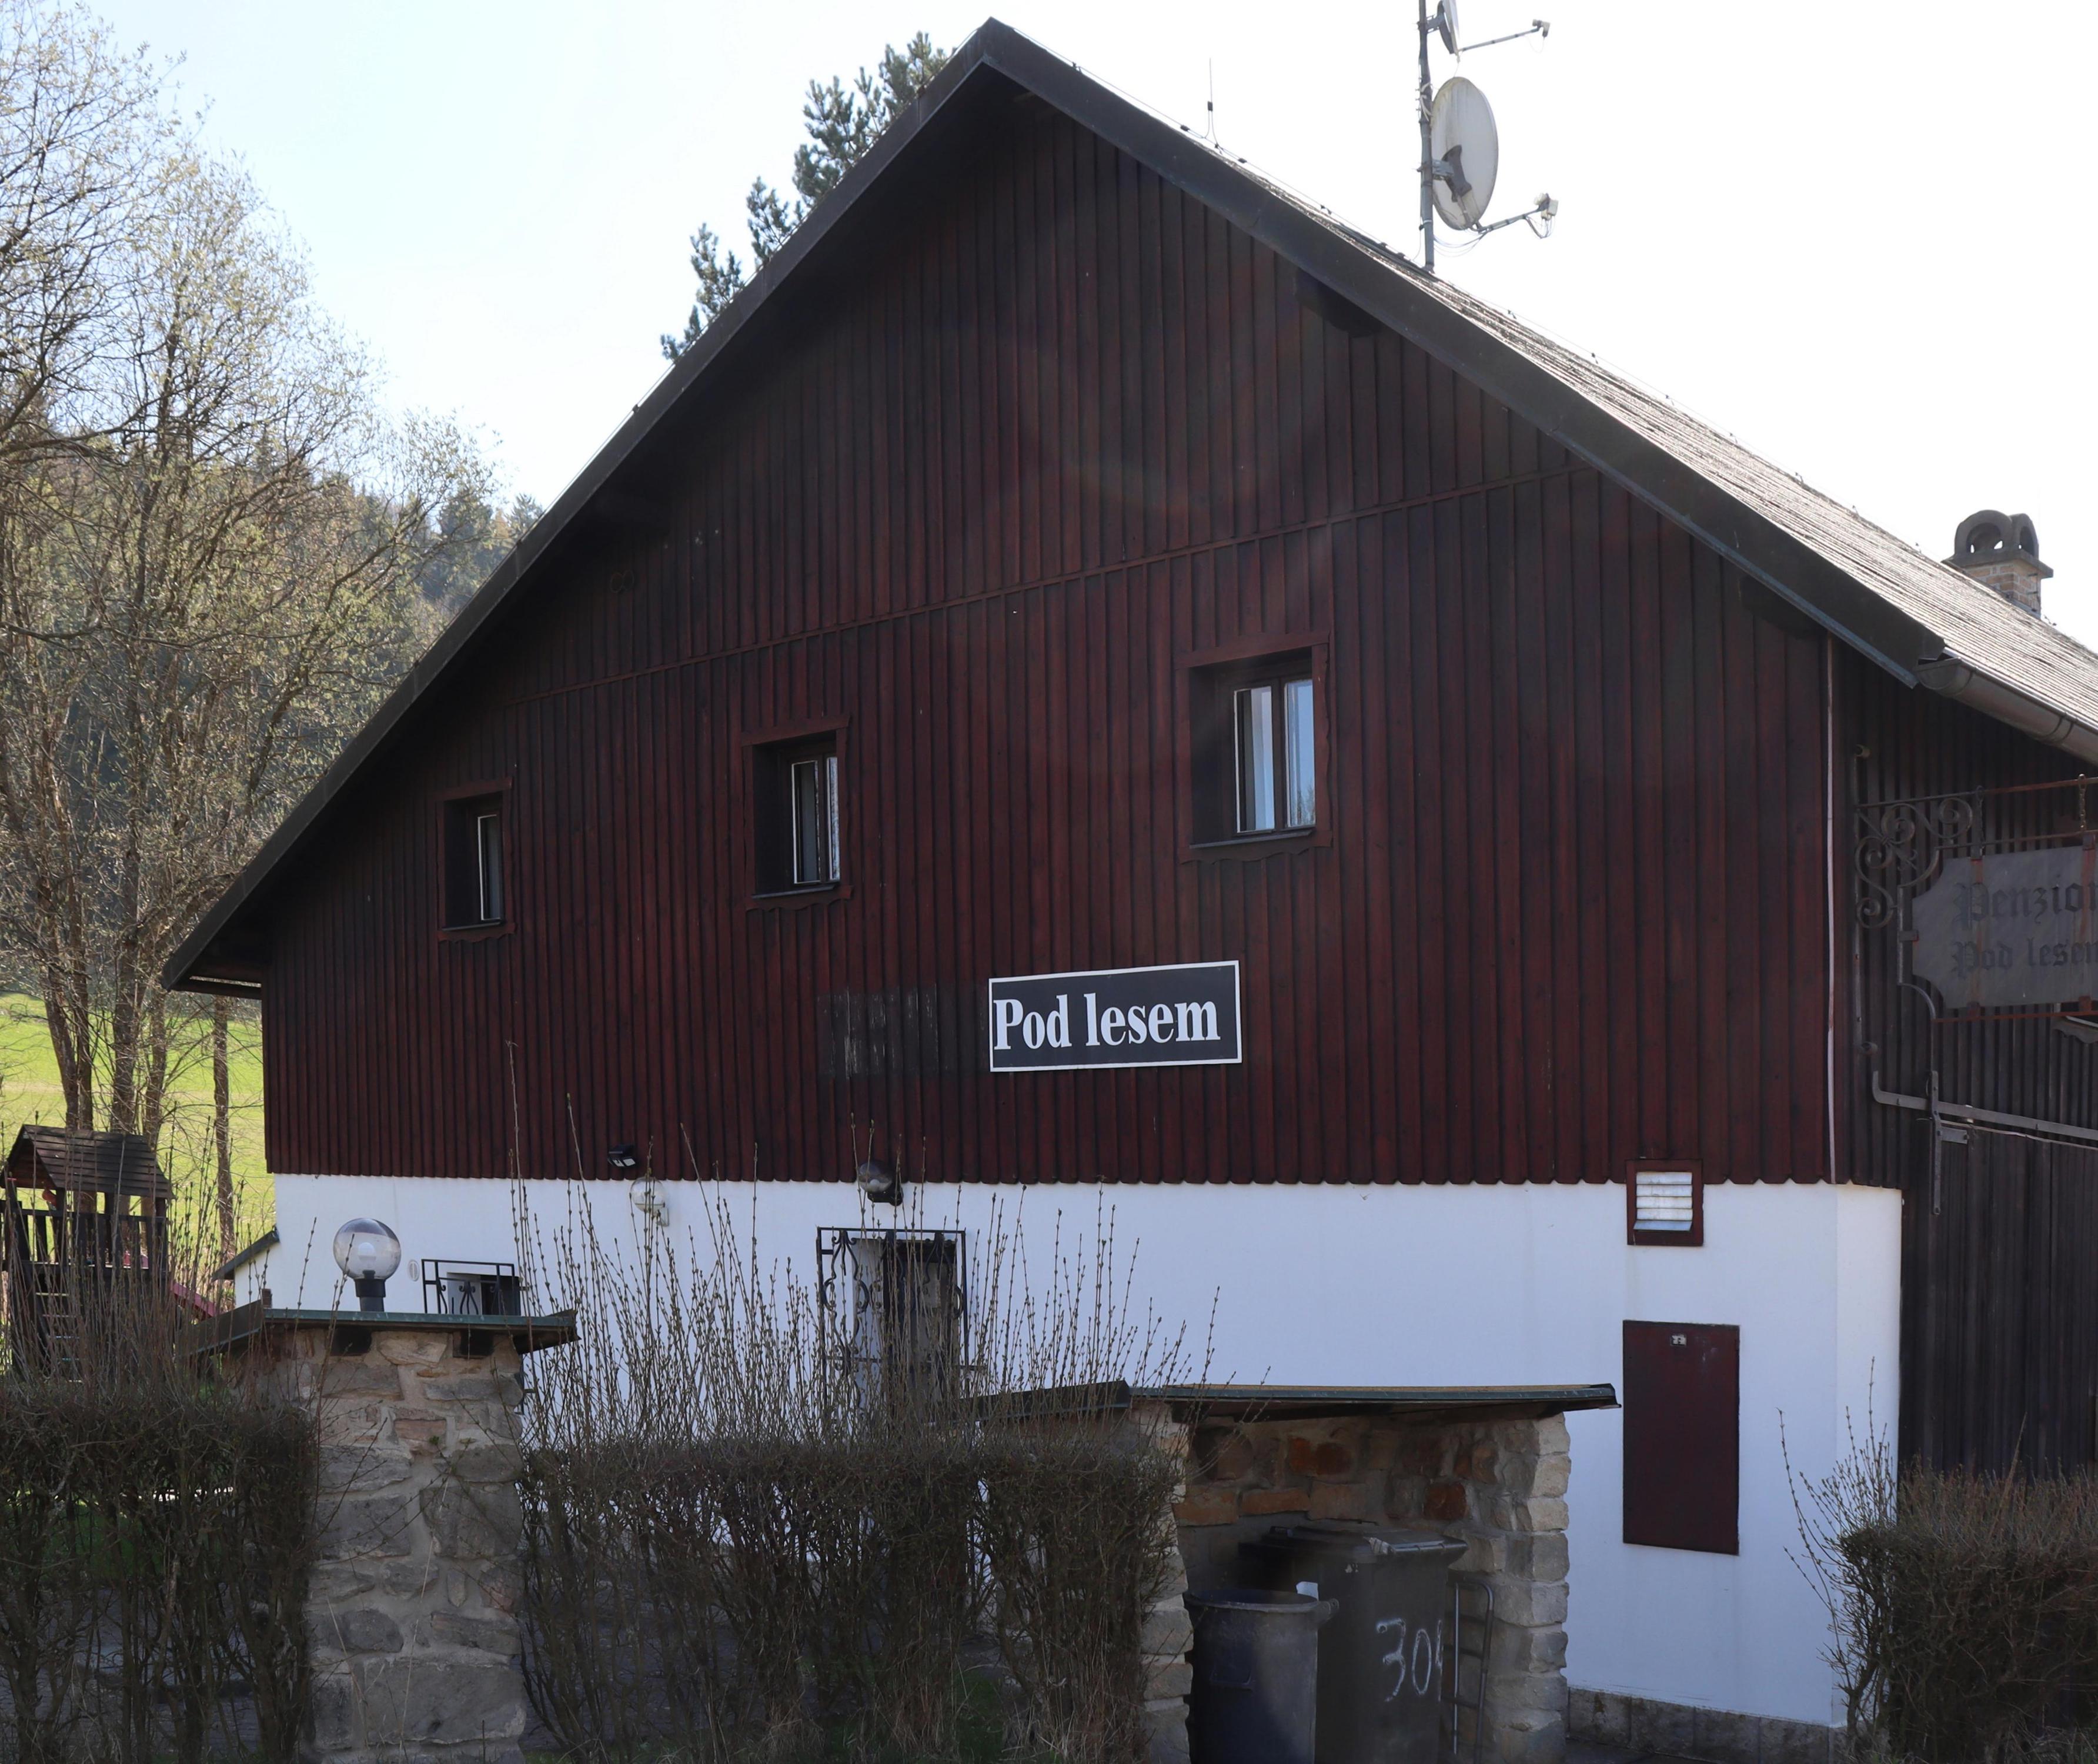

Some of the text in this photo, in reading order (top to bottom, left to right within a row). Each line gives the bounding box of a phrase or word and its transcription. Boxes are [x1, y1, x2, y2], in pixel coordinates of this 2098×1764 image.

[1950, 940, 2014, 980] Pod
[993, 993, 1221, 1050] Pod lesem
